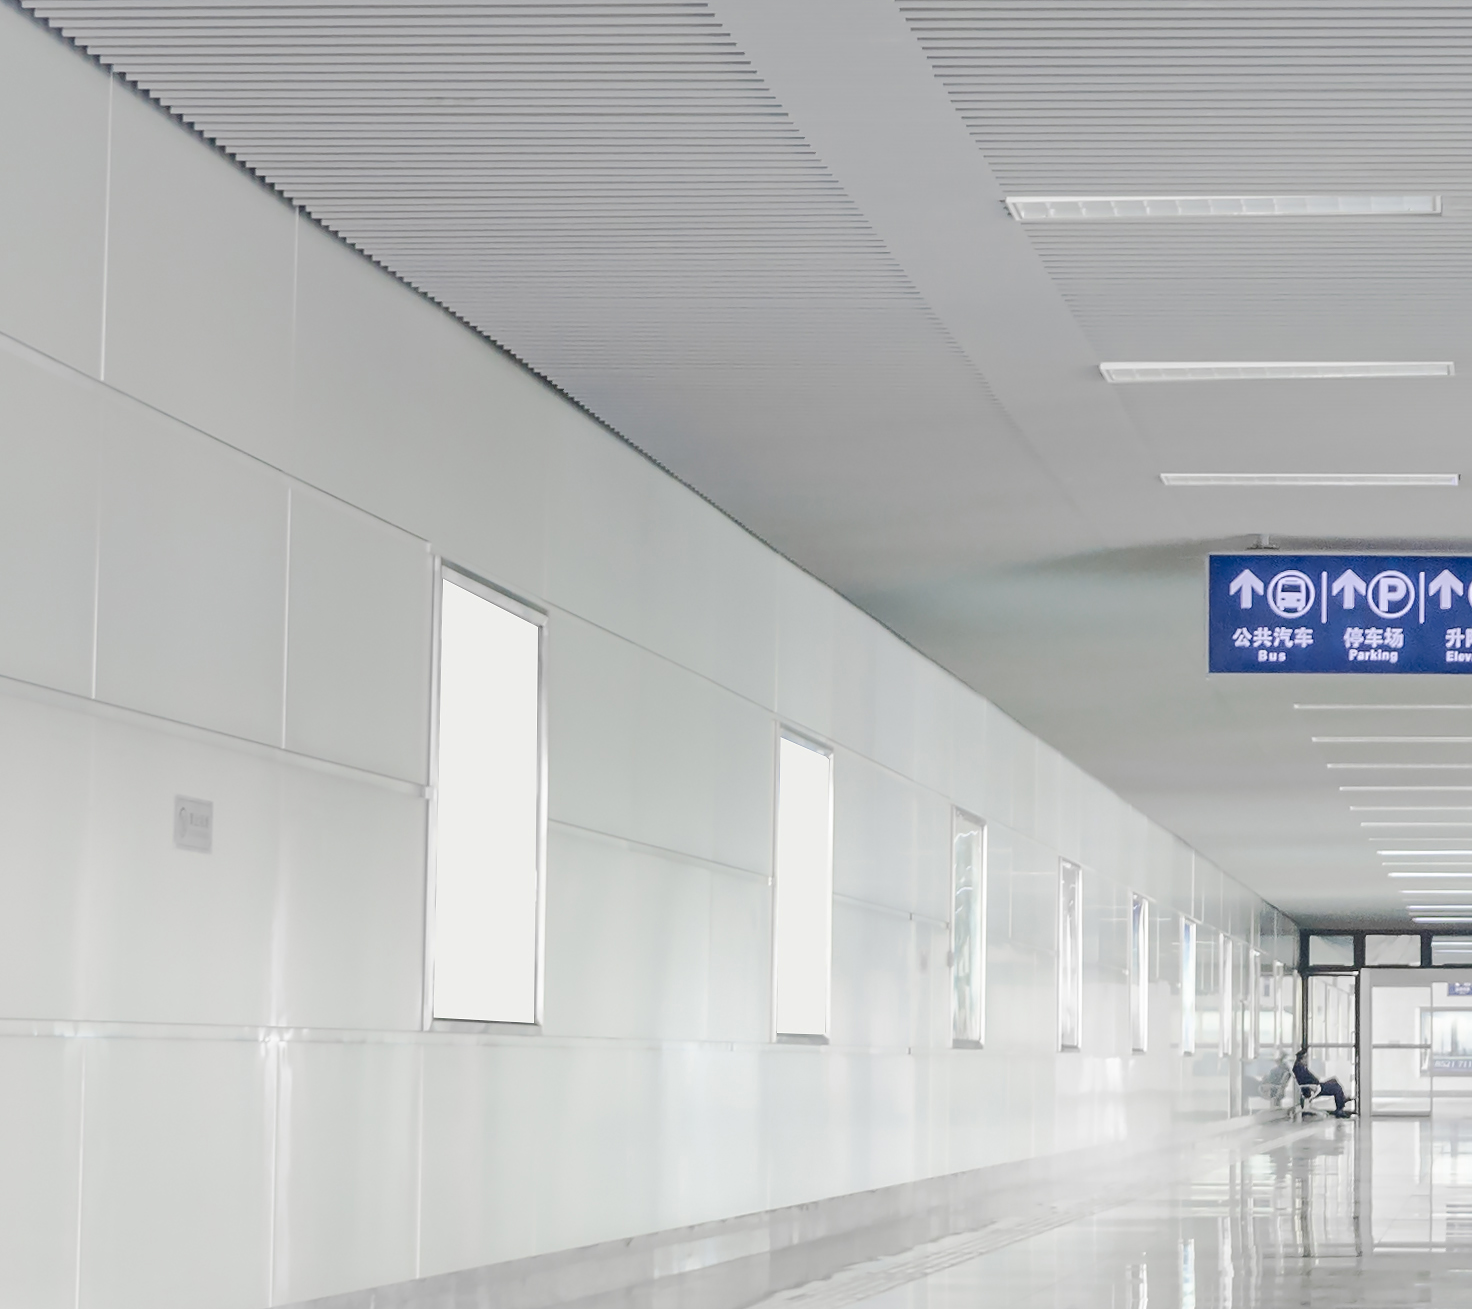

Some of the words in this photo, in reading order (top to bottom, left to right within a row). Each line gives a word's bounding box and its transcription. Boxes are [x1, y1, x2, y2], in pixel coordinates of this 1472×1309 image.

[1232, 626, 1314, 648] 公共汽车
[1343, 626, 1405, 649] 停车场
[1257, 649, 1287, 662] Bus
[1348, 649, 1399, 664] Parking
